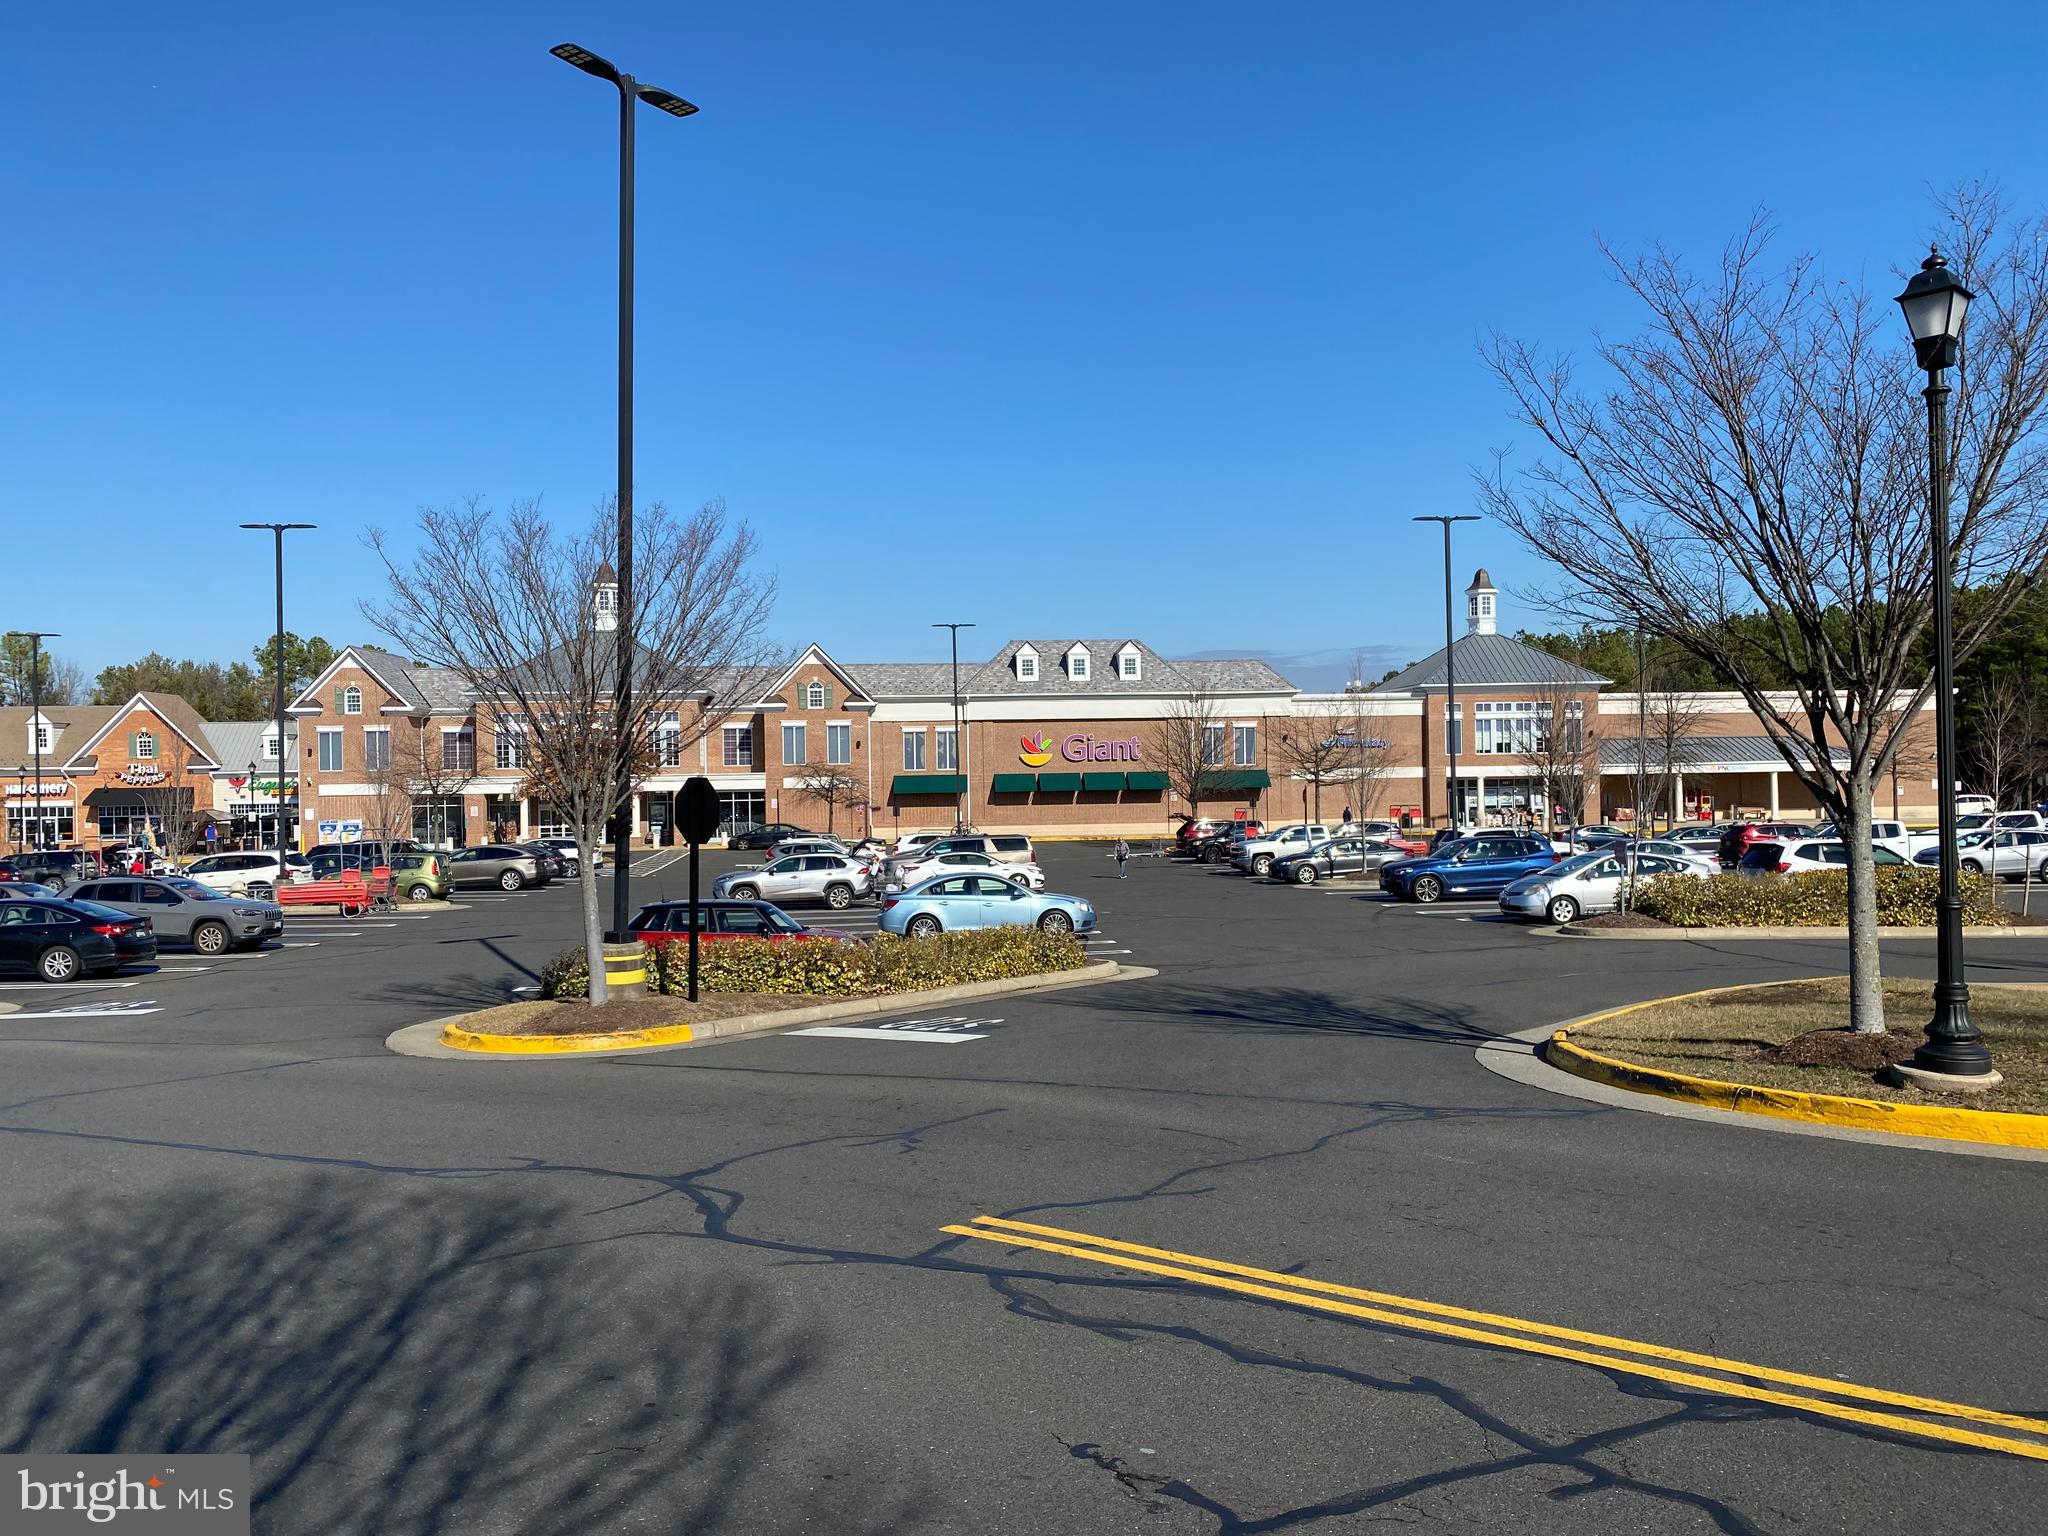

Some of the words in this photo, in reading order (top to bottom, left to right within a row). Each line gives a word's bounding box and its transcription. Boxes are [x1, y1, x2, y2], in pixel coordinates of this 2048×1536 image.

[1062, 733, 1142, 761] Giant
[127, 763, 158, 775] Thai
[120, 771, 166, 785] PEPPERS
